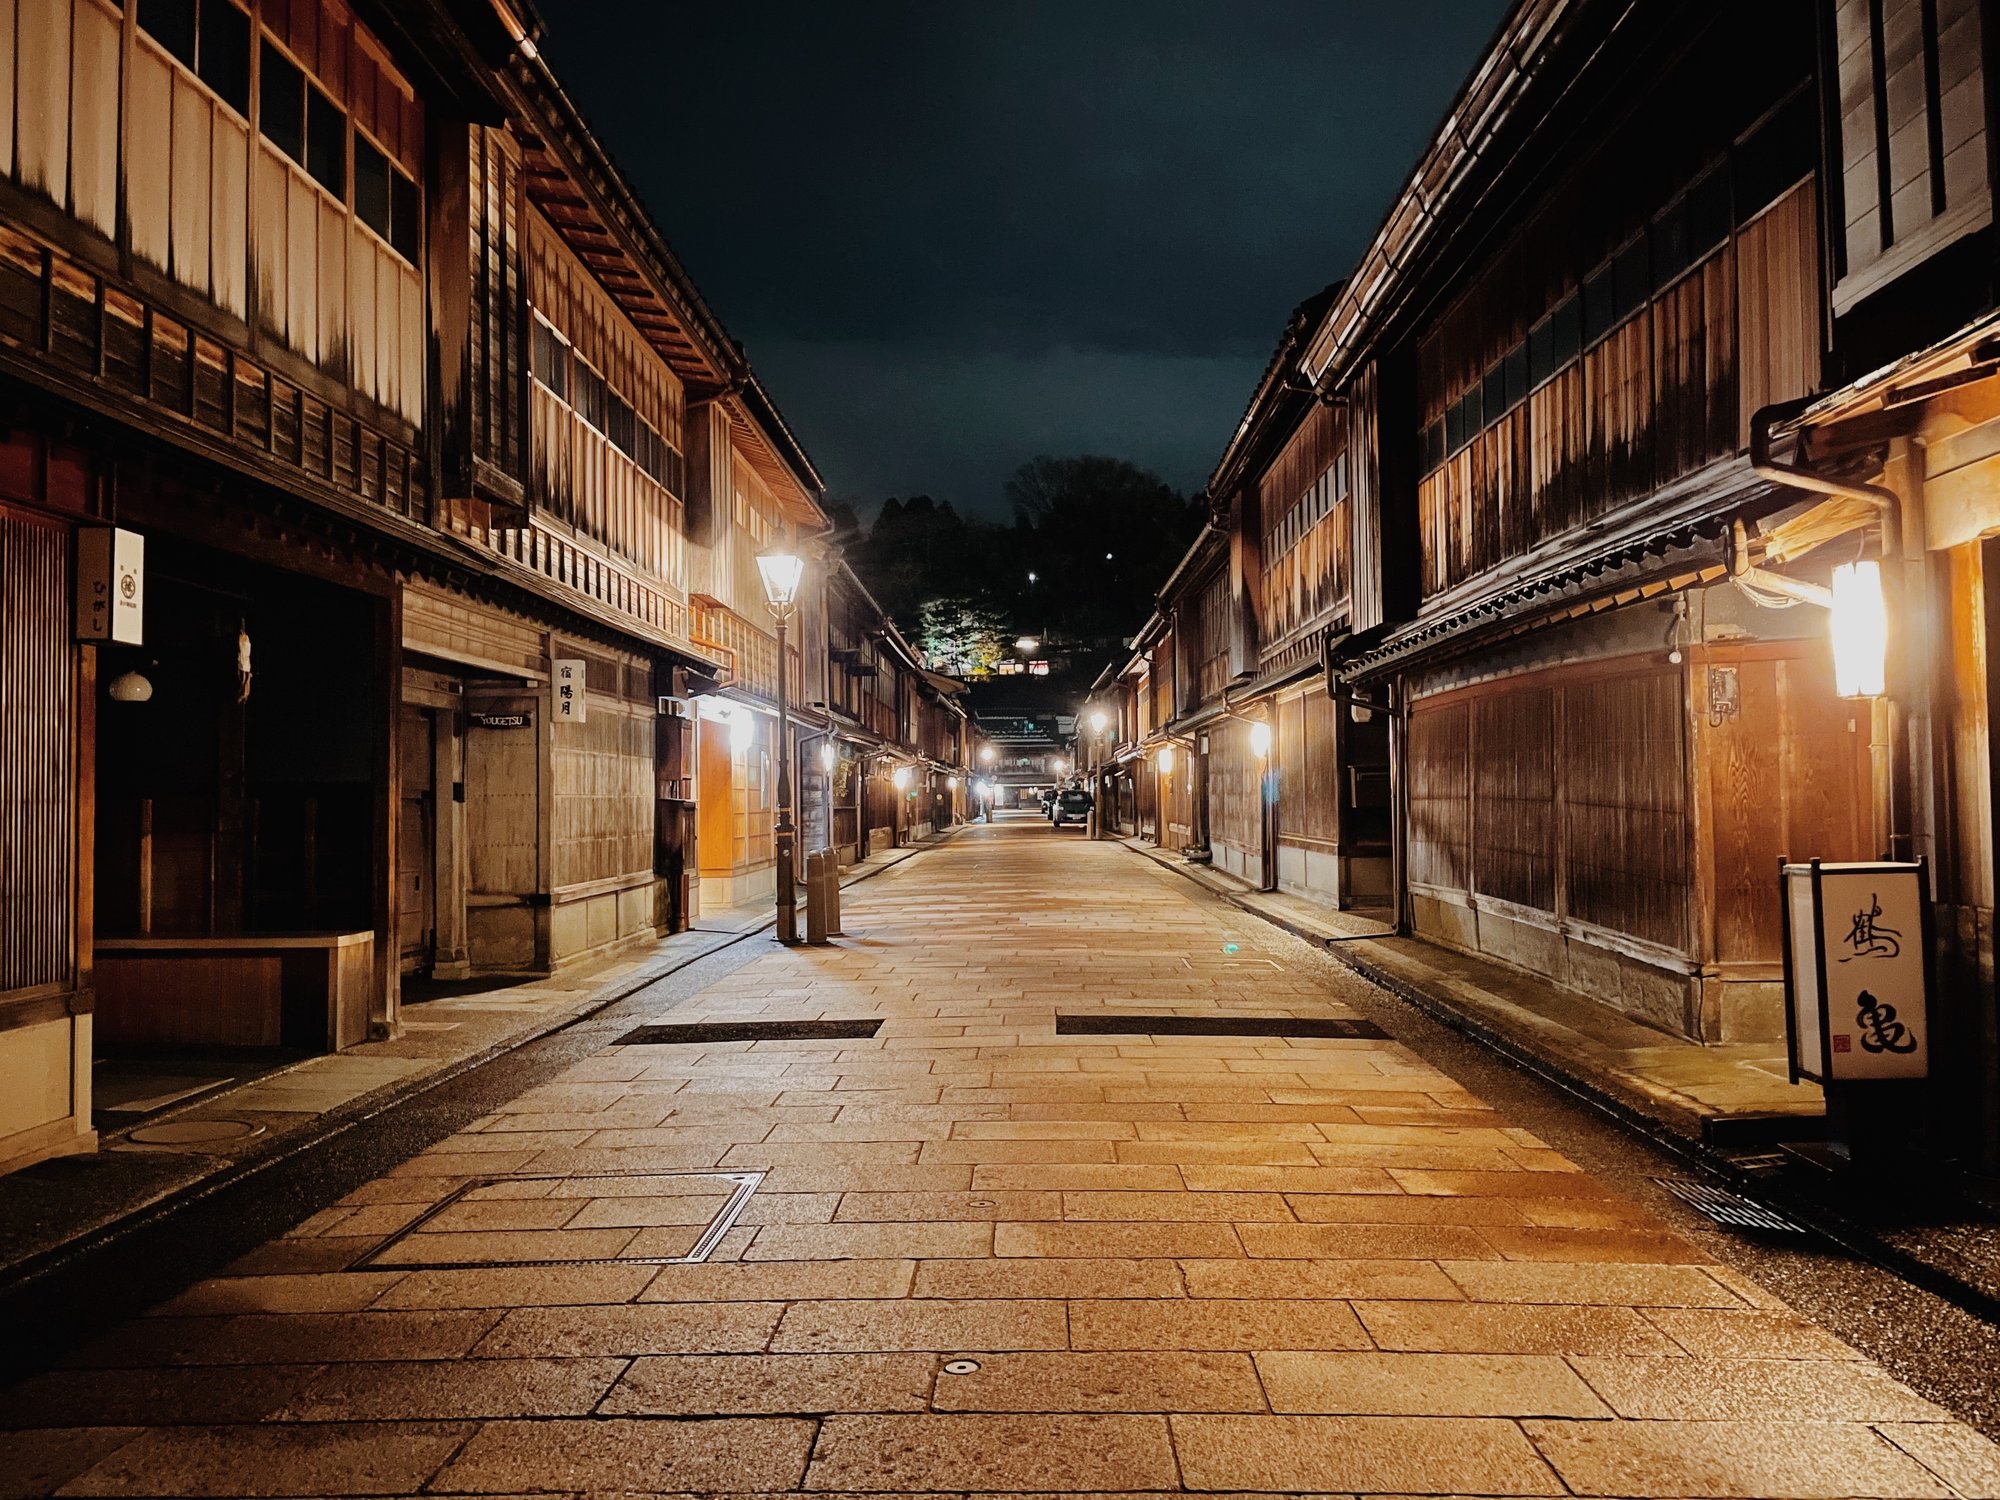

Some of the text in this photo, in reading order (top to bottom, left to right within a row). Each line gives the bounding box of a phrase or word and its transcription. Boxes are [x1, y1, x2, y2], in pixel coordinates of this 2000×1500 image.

[93, 581, 106, 632] ひがし
[481, 716, 523, 726] YOUGETSU
